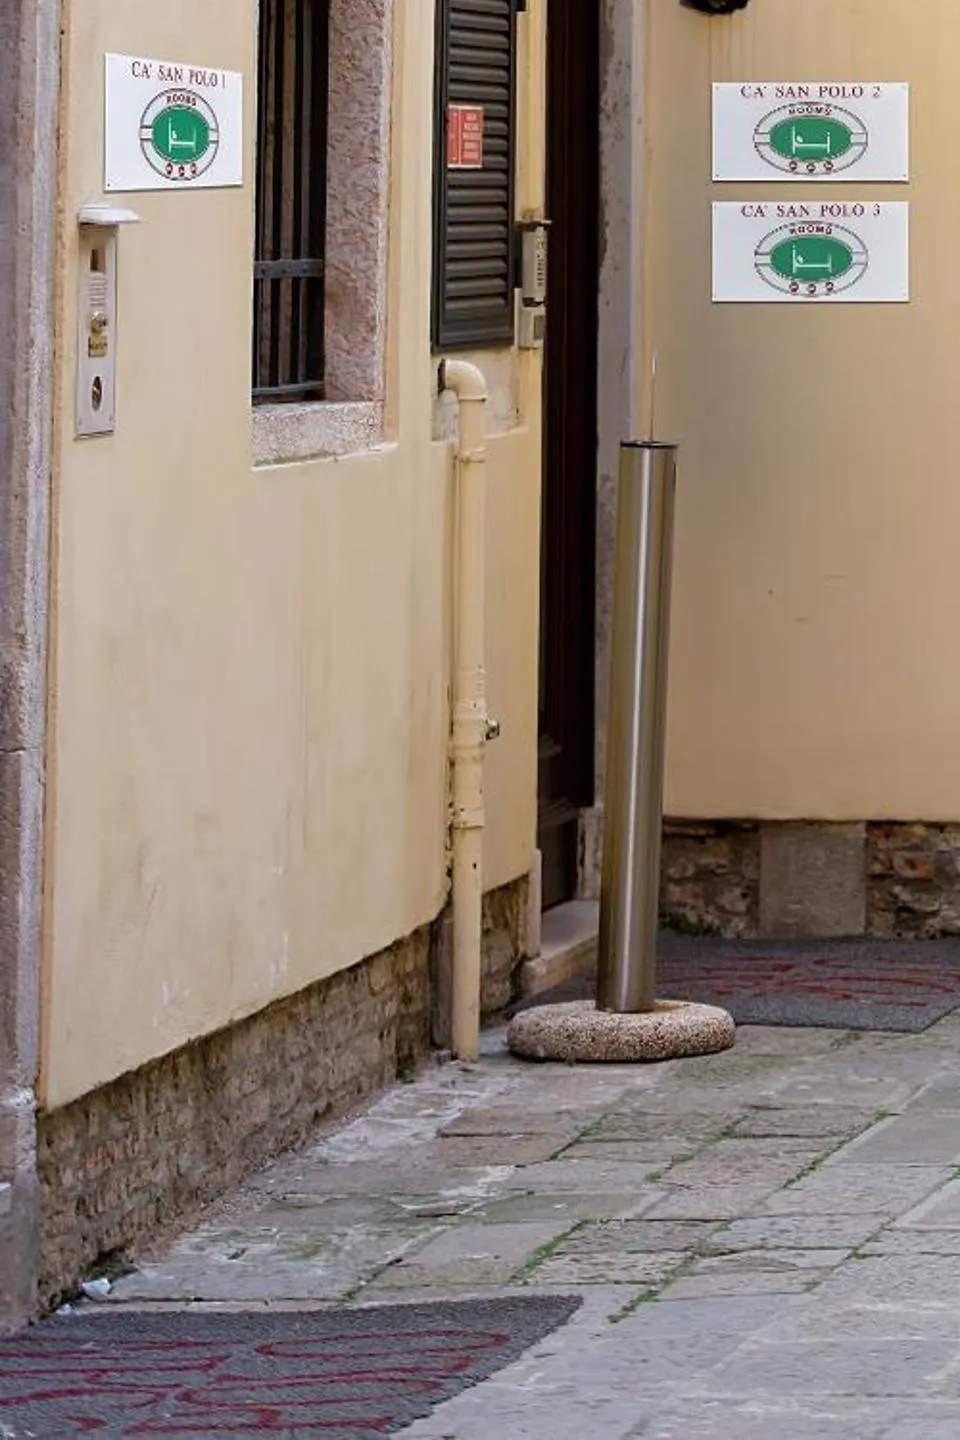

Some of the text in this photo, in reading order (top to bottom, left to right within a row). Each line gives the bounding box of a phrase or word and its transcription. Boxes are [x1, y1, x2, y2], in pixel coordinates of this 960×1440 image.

[131, 61, 153, 79] CA'
[157, 65, 183, 83] SAN
[189, 69, 218, 88] POLO
[740, 85, 881, 99] CA' SAN POLO 2
[741, 203, 881, 218] CA' SAN POLO 3
